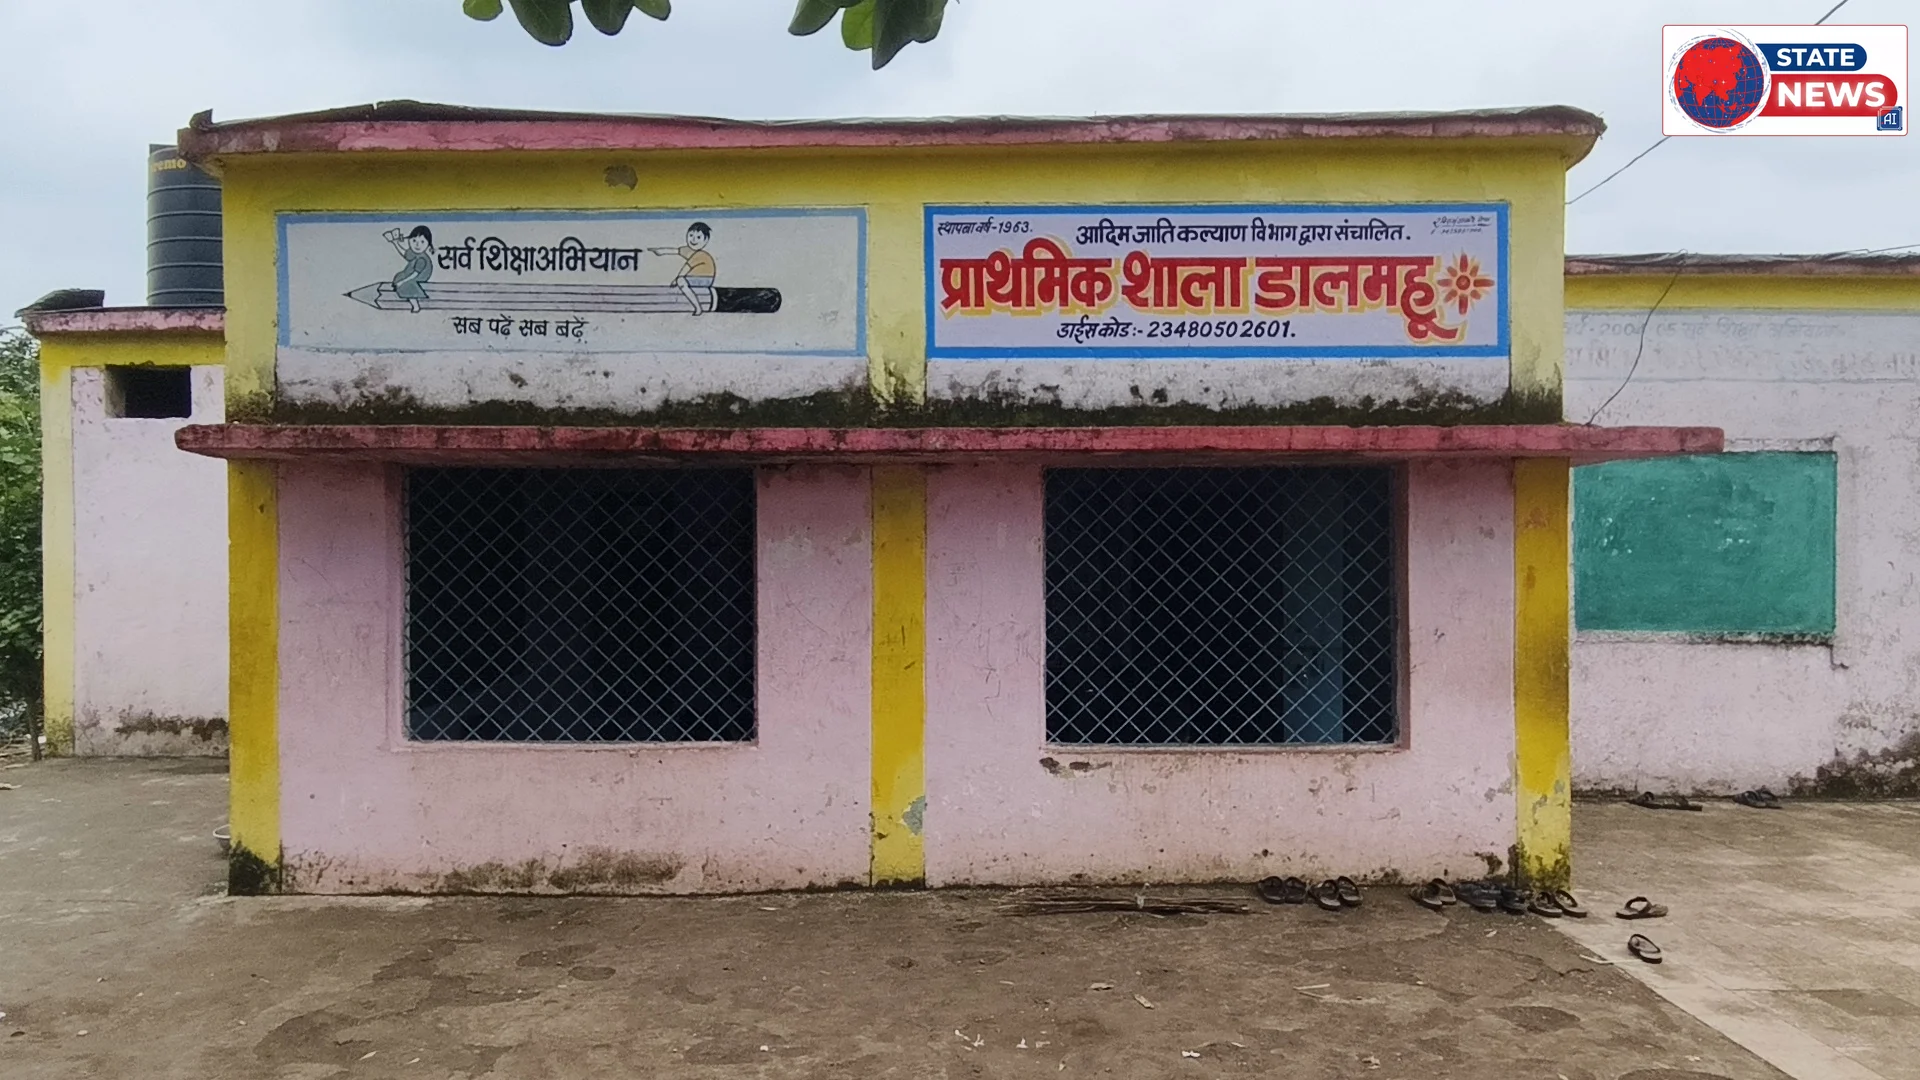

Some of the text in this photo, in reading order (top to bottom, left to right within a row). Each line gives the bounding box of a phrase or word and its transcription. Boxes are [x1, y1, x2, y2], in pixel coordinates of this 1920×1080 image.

[1076, 218, 1133, 246] आदिम
[1132, 217, 1176, 244] जाति
[1176, 225, 1249, 243] कल्याण
[1250, 216, 1298, 242] विभाग
[1298, 224, 1333, 246] द्वारा
[437, 236, 476, 270] सर्व
[939, 237, 1460, 341] प्राथमिक शाला डालमहू
[451, 316, 484, 335] सब
[518, 319, 549, 337] सब
